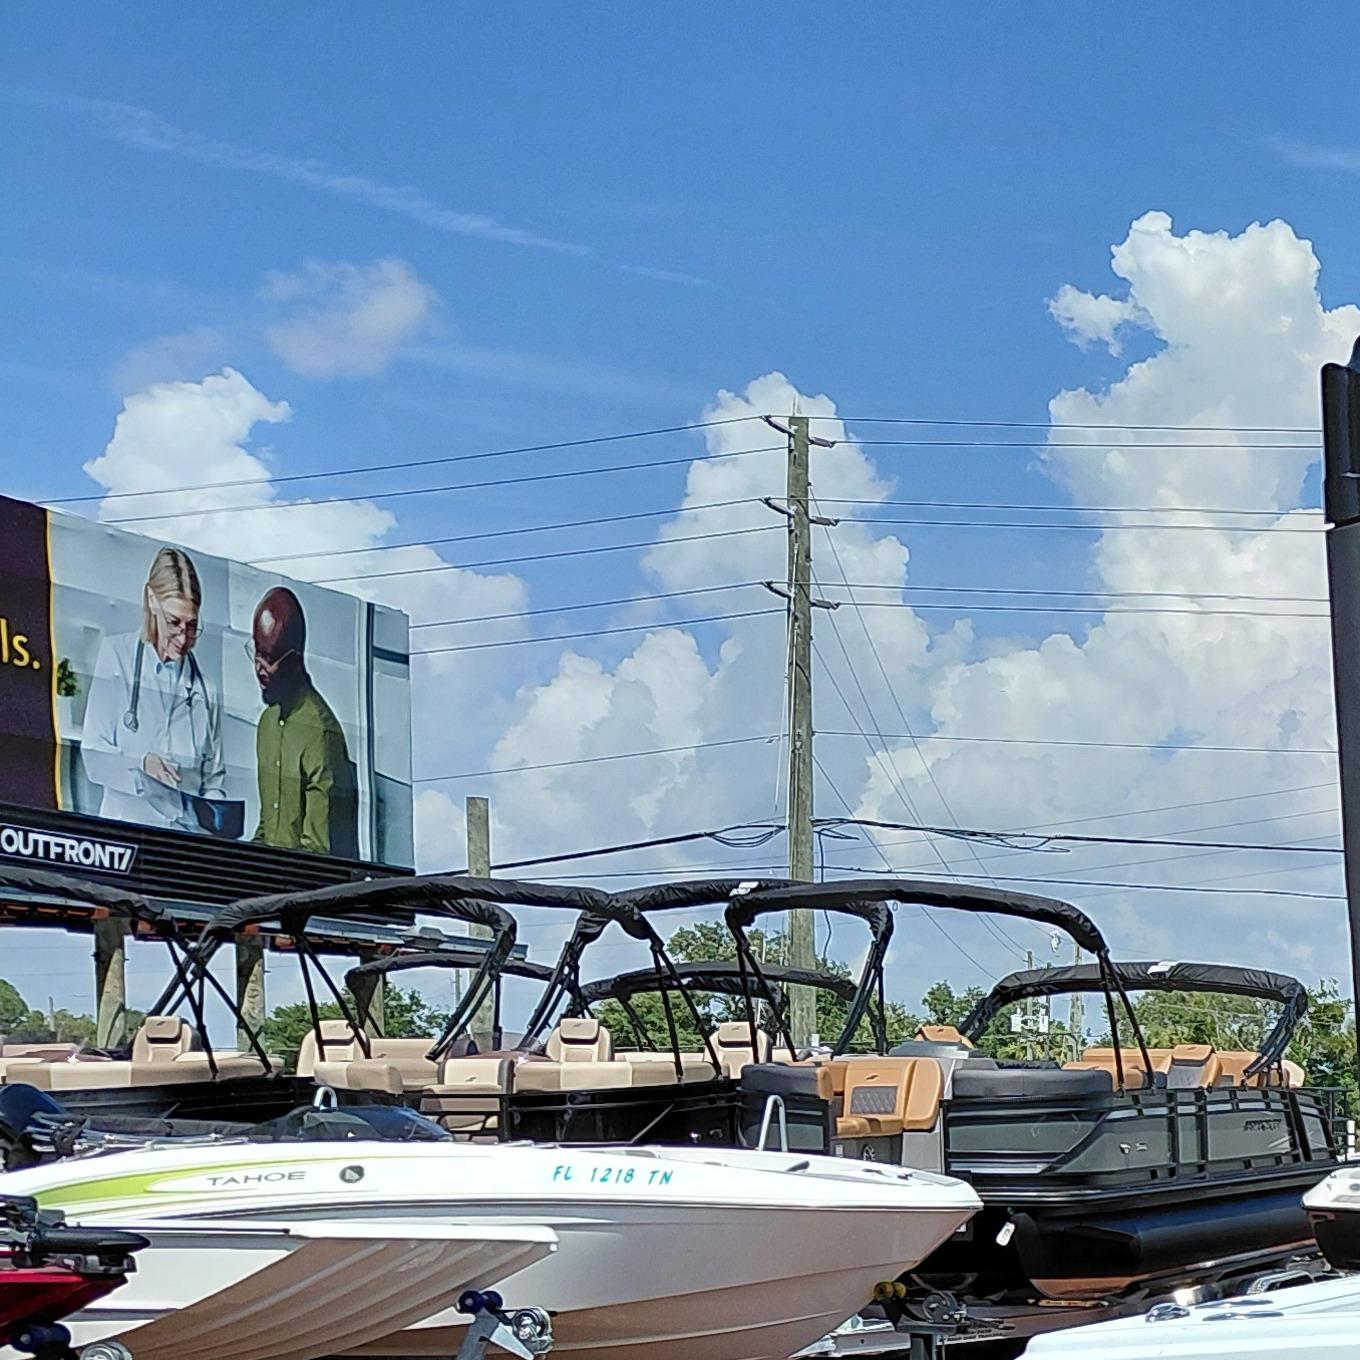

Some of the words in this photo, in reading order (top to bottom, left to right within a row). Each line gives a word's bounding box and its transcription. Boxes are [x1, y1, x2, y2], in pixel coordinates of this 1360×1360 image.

[207, 1170, 307, 1187] TAHOE
[553, 1165, 572, 1181] FL
[591, 1167, 635, 1184] 1218
[648, 1170, 674, 1186] TN
